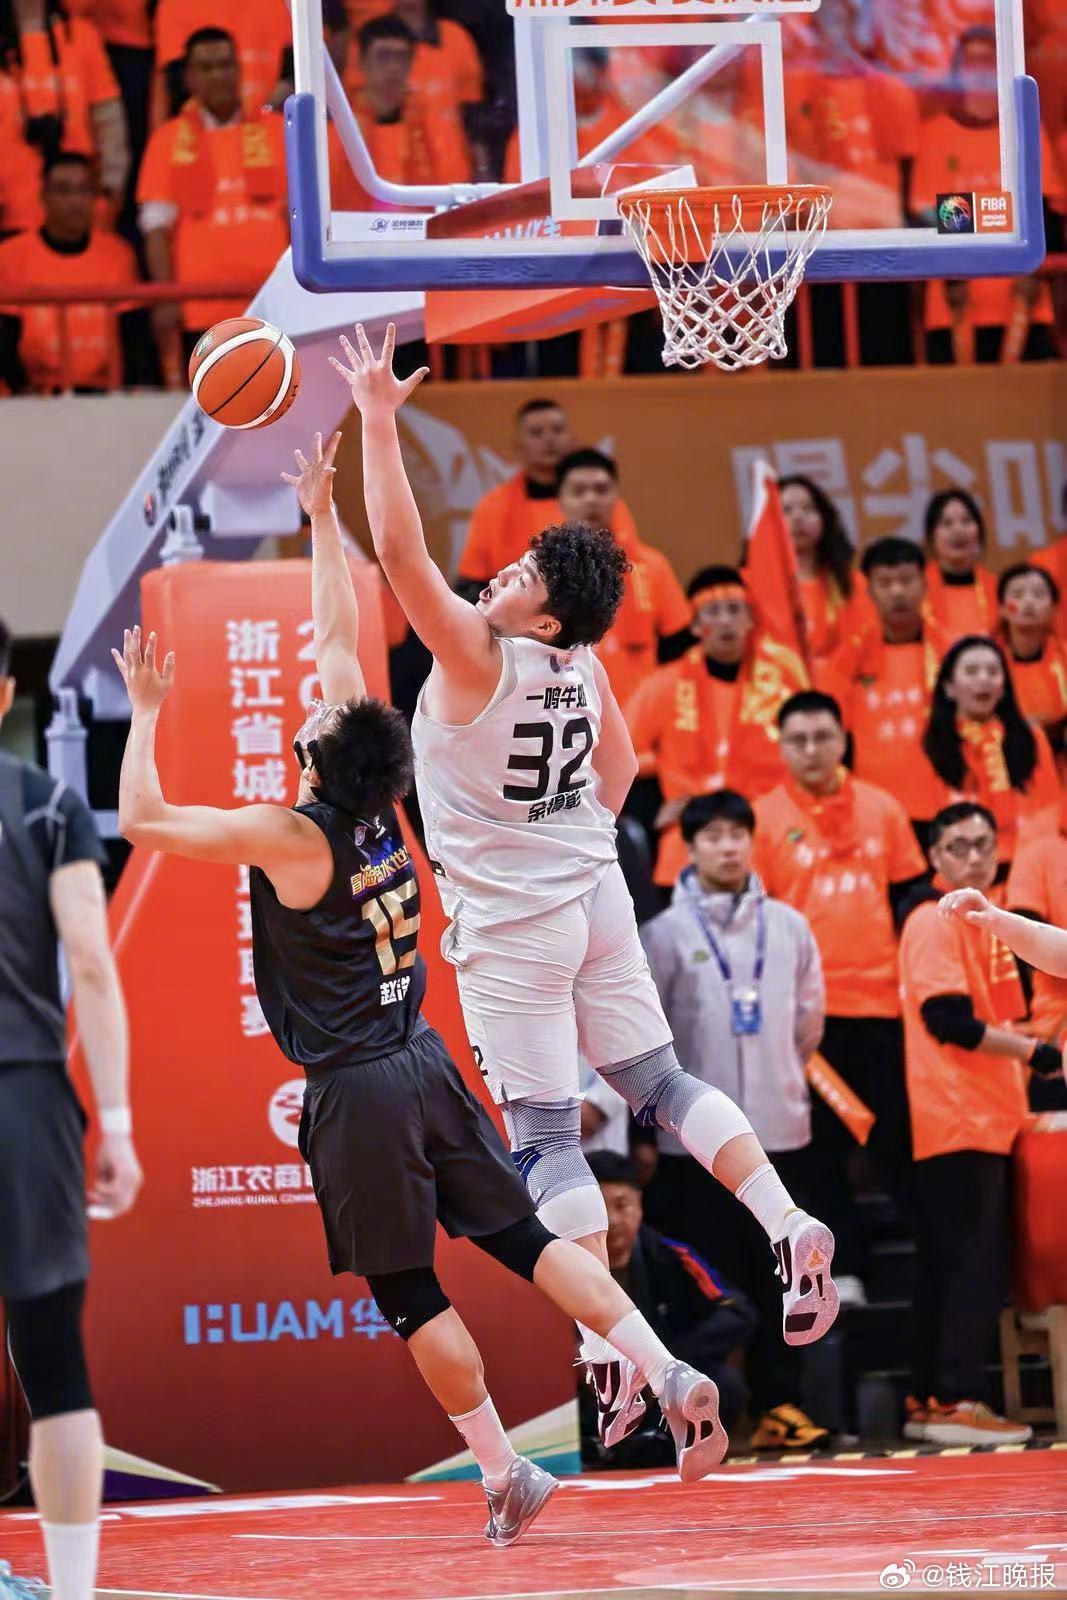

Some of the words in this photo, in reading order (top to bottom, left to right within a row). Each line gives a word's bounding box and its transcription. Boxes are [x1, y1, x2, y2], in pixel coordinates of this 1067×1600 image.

[980, 196, 1007, 212] FIBA
[503, 716, 594, 802] 32
[361, 877, 421, 976] 15
[191, 1163, 313, 1193] 浙江农商
[350, 1298, 399, 1341] 华
